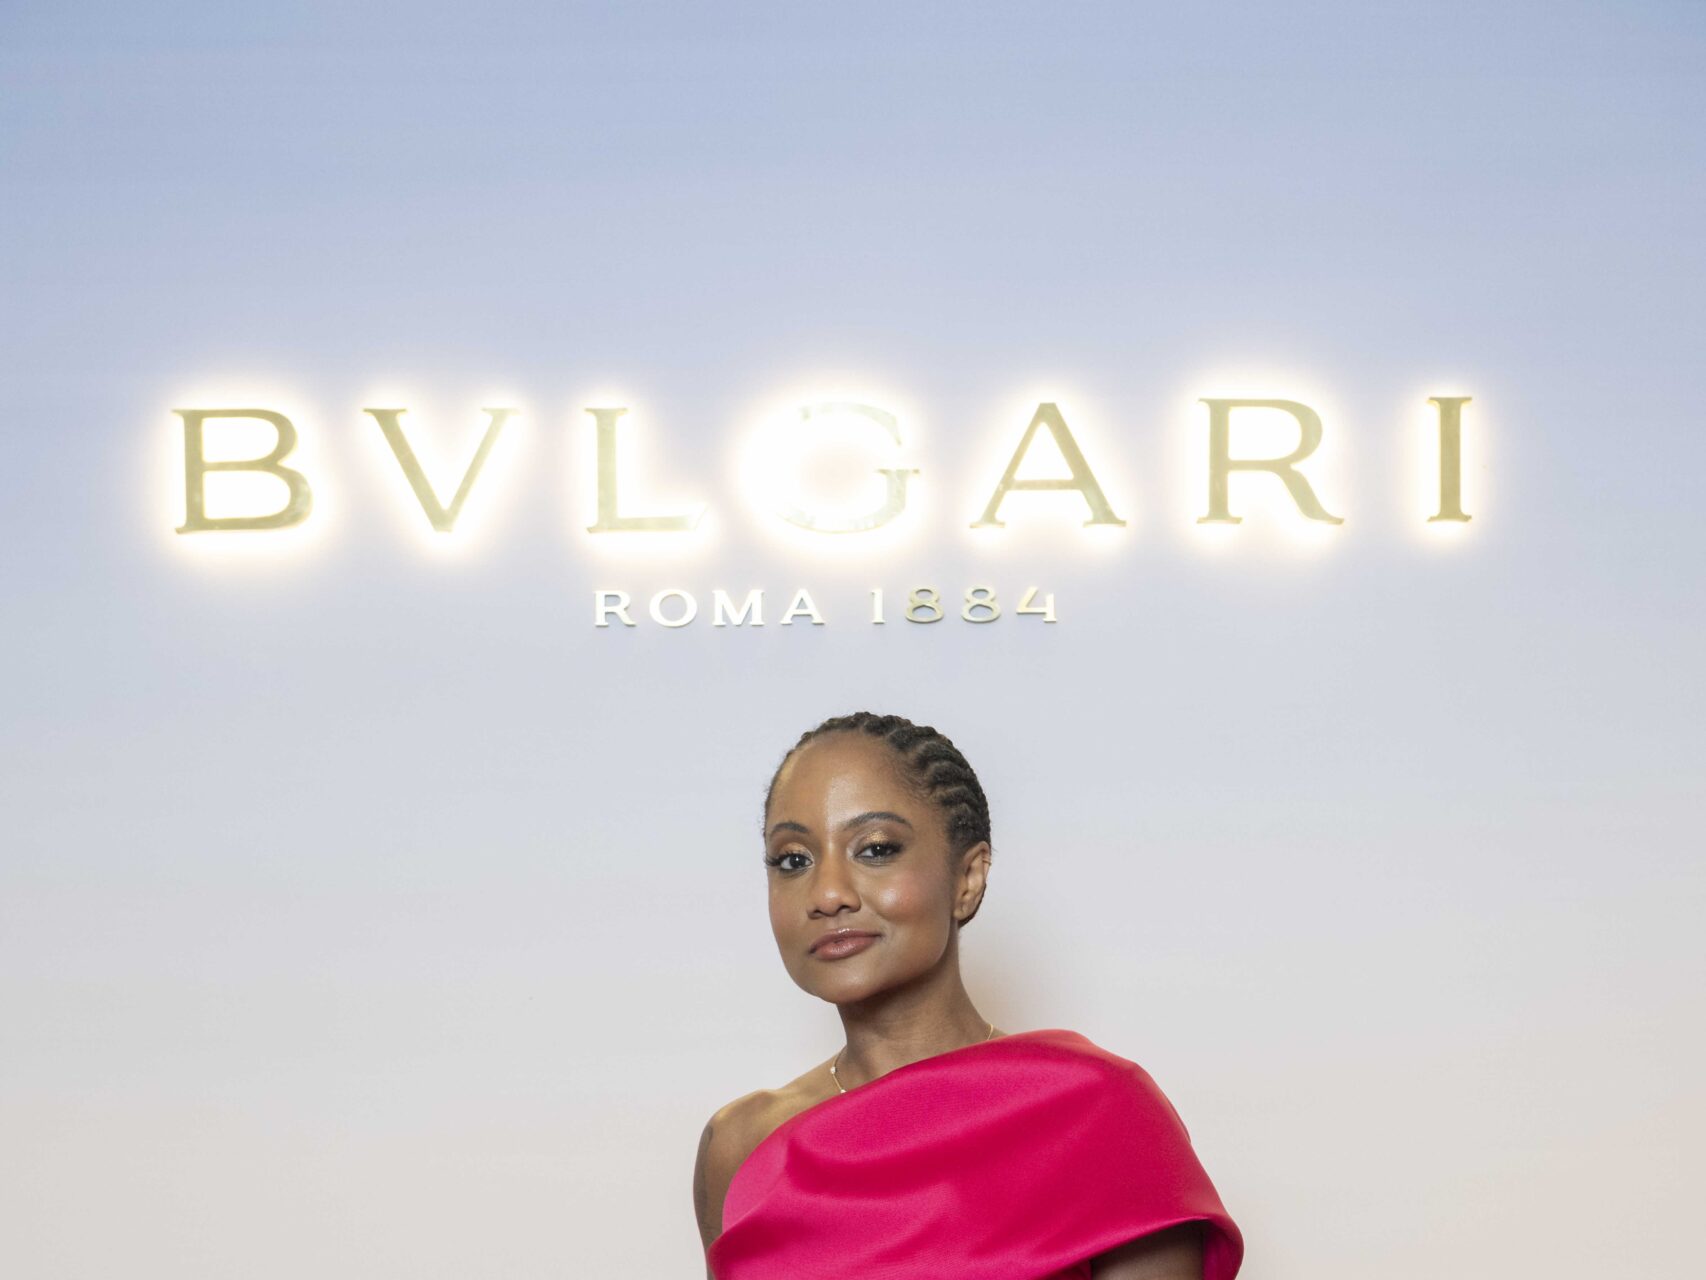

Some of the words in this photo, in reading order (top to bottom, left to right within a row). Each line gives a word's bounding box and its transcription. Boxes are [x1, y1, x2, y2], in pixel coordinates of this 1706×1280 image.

[171, 395, 1474, 535] BVLGARI
[593, 588, 826, 628] ROMA
[870, 585, 1058, 625] 1884
